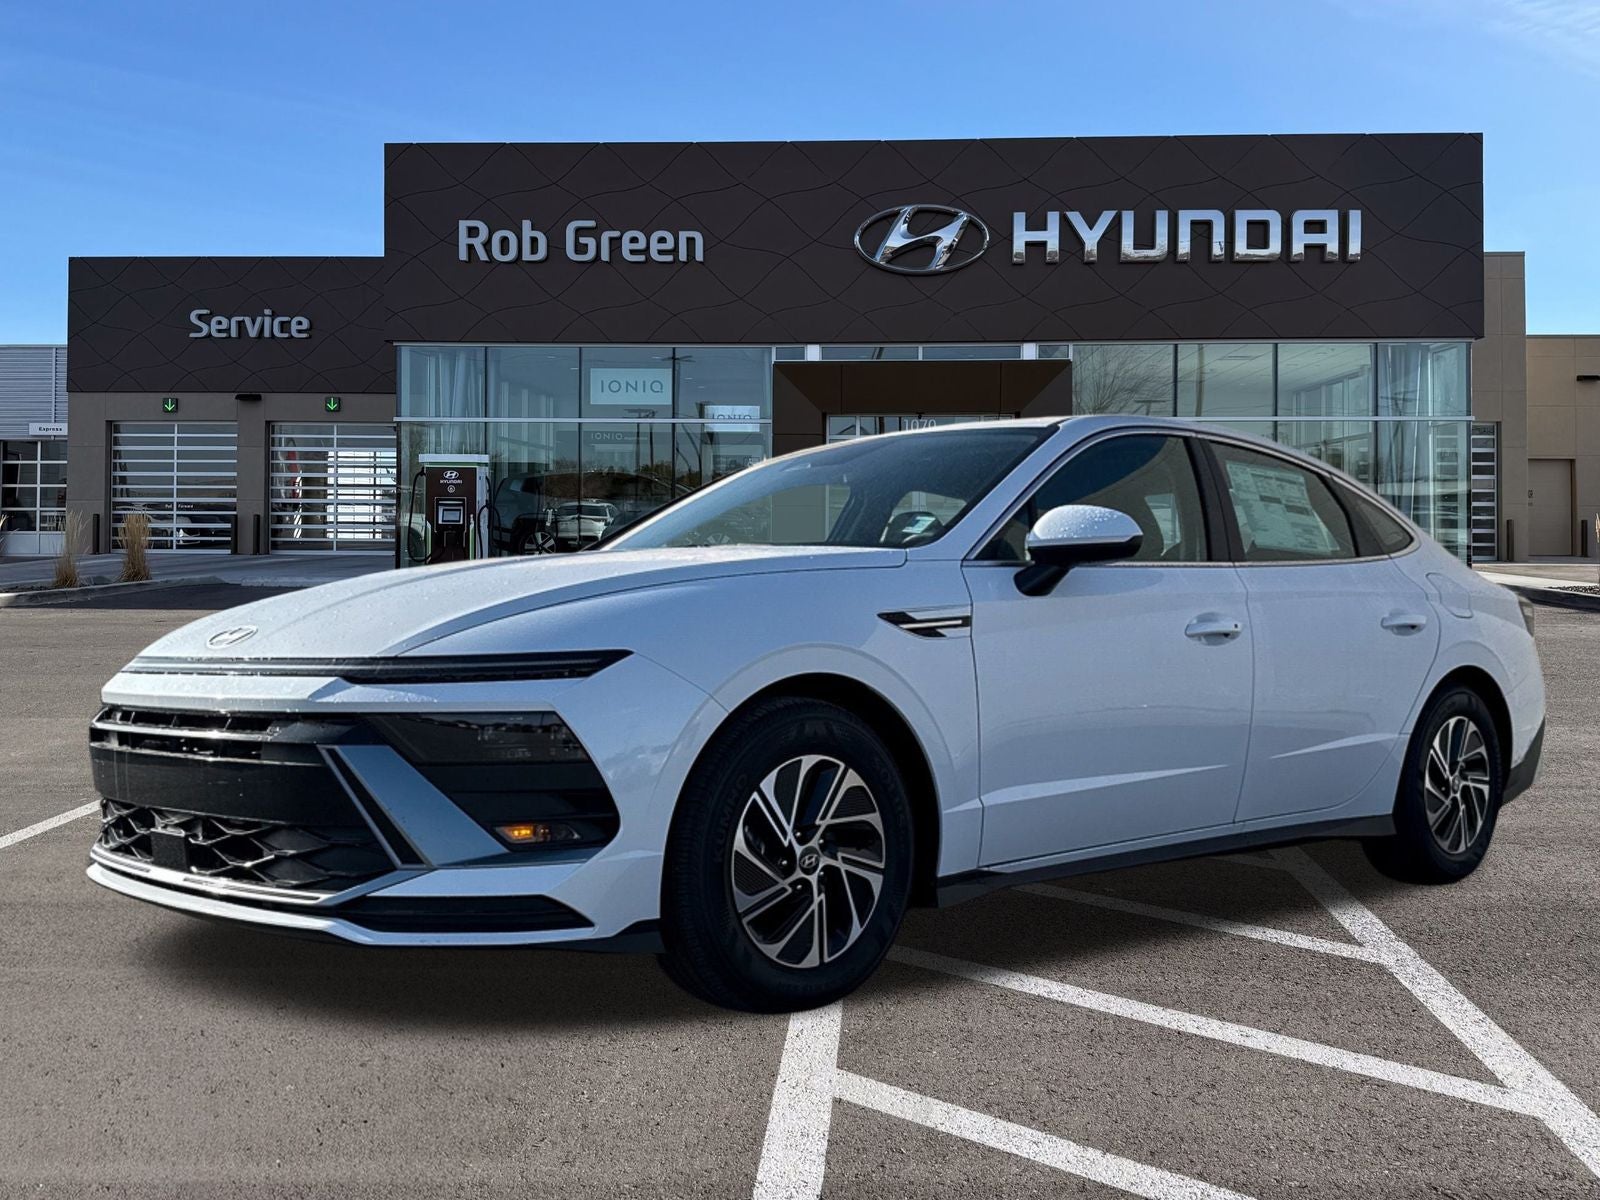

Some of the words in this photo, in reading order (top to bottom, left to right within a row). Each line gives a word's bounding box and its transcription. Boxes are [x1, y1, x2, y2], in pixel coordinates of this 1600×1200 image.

[458, 219, 548, 263] Rob
[565, 219, 704, 263] Green
[1012, 210, 1362, 264] HYUNDAI
[189, 308, 310, 338] Service
[600, 380, 664, 394] IONIQ
